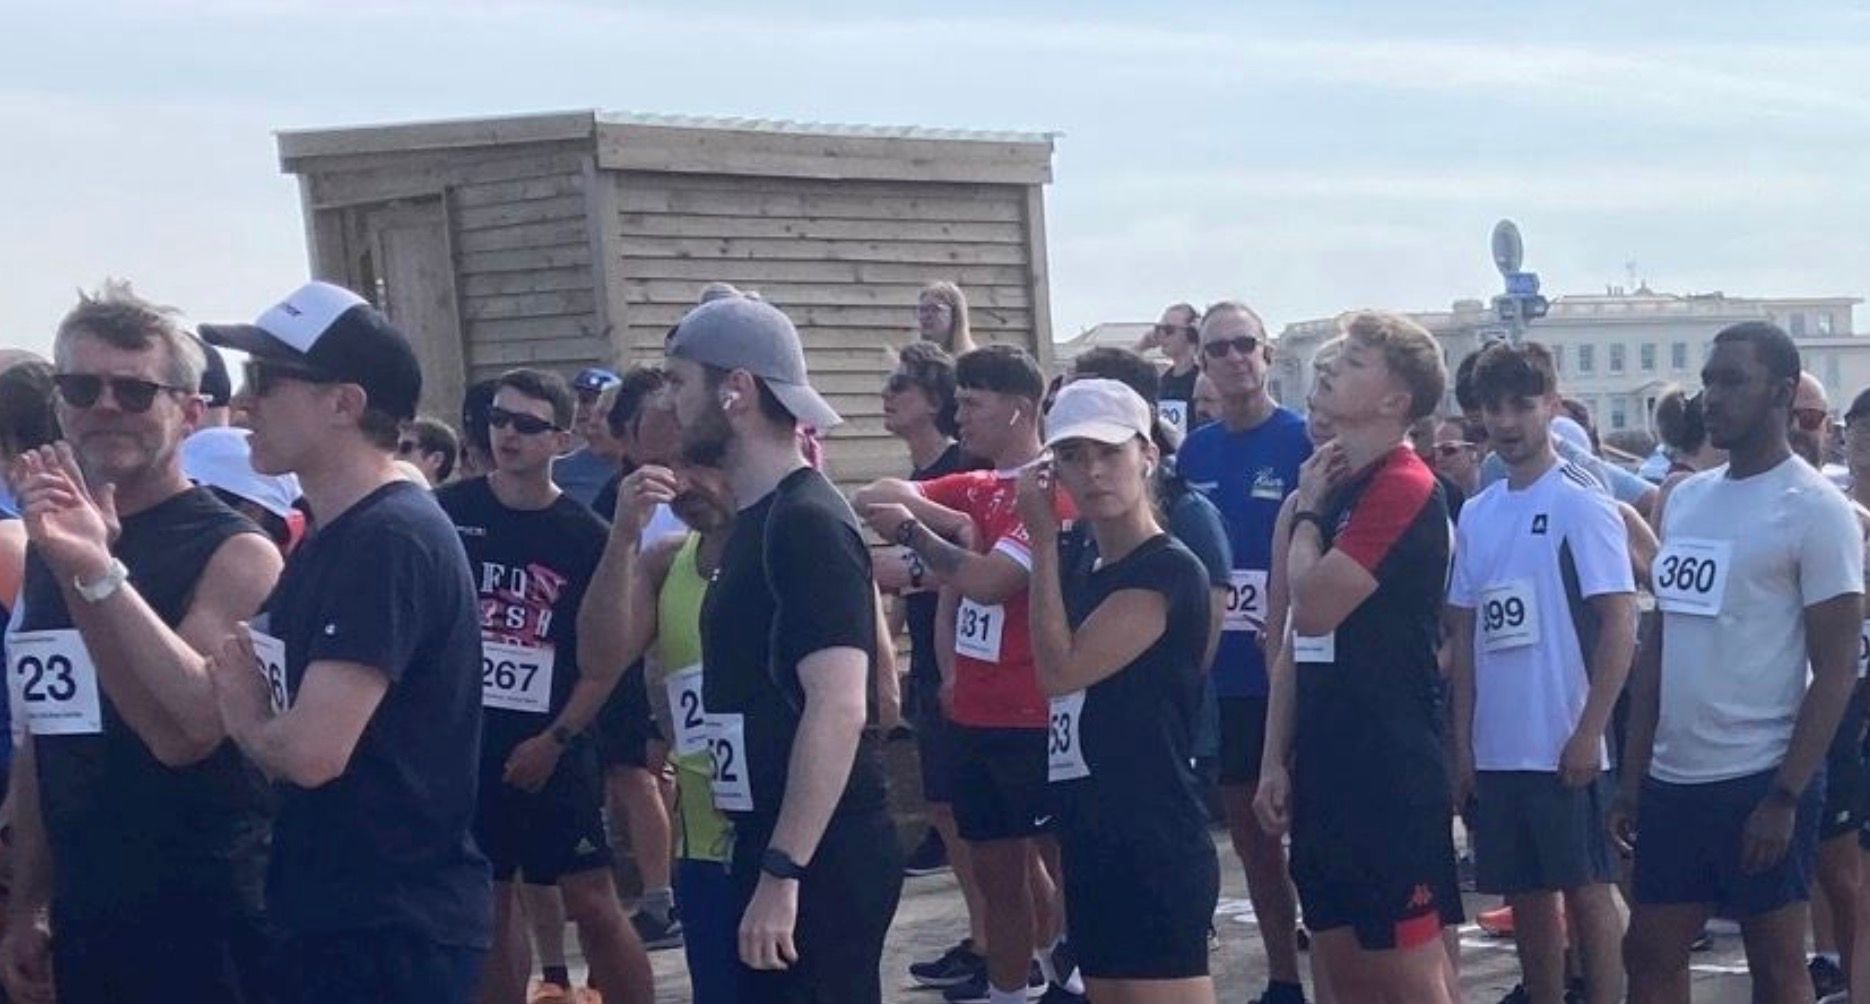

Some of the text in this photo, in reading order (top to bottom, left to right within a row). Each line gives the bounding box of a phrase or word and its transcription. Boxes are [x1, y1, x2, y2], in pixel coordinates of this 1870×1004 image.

[1659, 555, 1716, 594] 360
[17, 654, 76, 701] 23
[482, 659, 539, 692] 267
